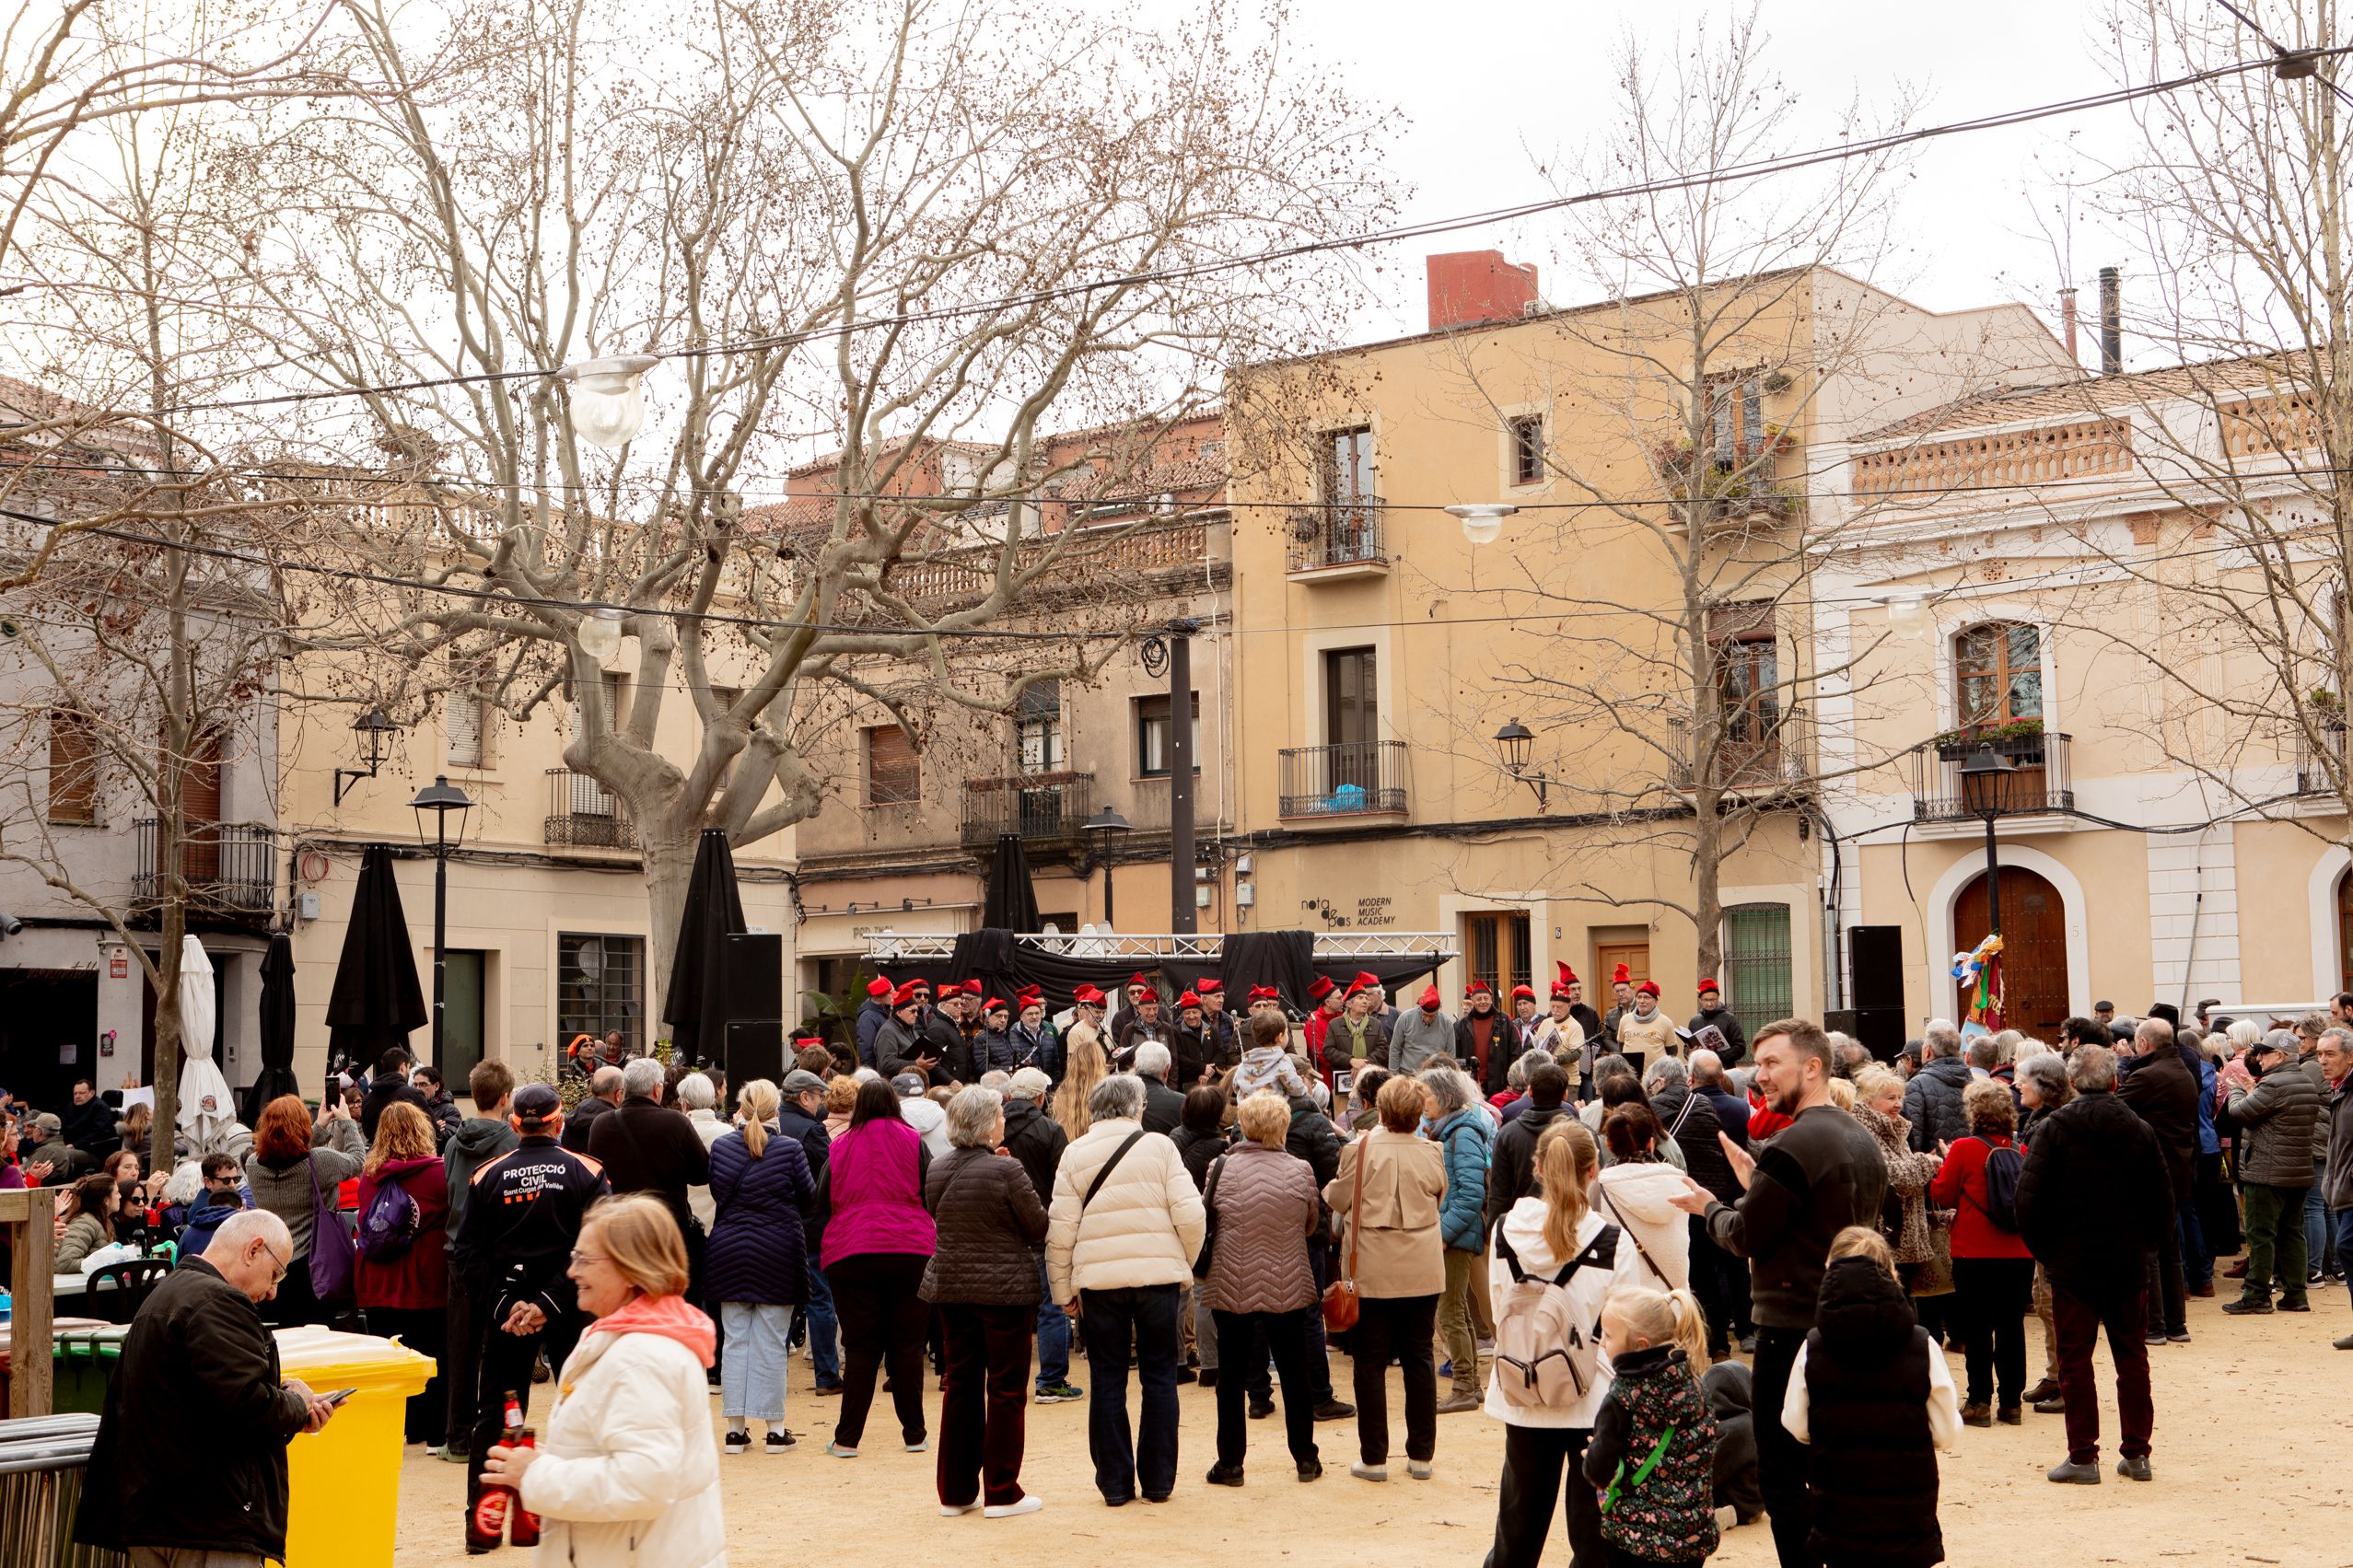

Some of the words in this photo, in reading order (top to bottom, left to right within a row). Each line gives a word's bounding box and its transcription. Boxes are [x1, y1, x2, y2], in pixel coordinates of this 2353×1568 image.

[1301, 897, 1330, 910] nota
[1357, 897, 1392, 907] MODERN
[1357, 907, 1383, 916] MUSIC
[1327, 916, 1351, 932] pas
[1357, 915, 1396, 926] ACADEMY
[1555, 927, 1561, 938] 6
[503, 1164, 566, 1180] PROTECCIÓ
[520, 1174, 547, 1187] CIVIL
[503, 1189, 518, 1197] Sant
[518, 1186, 537, 1194] Cugat
